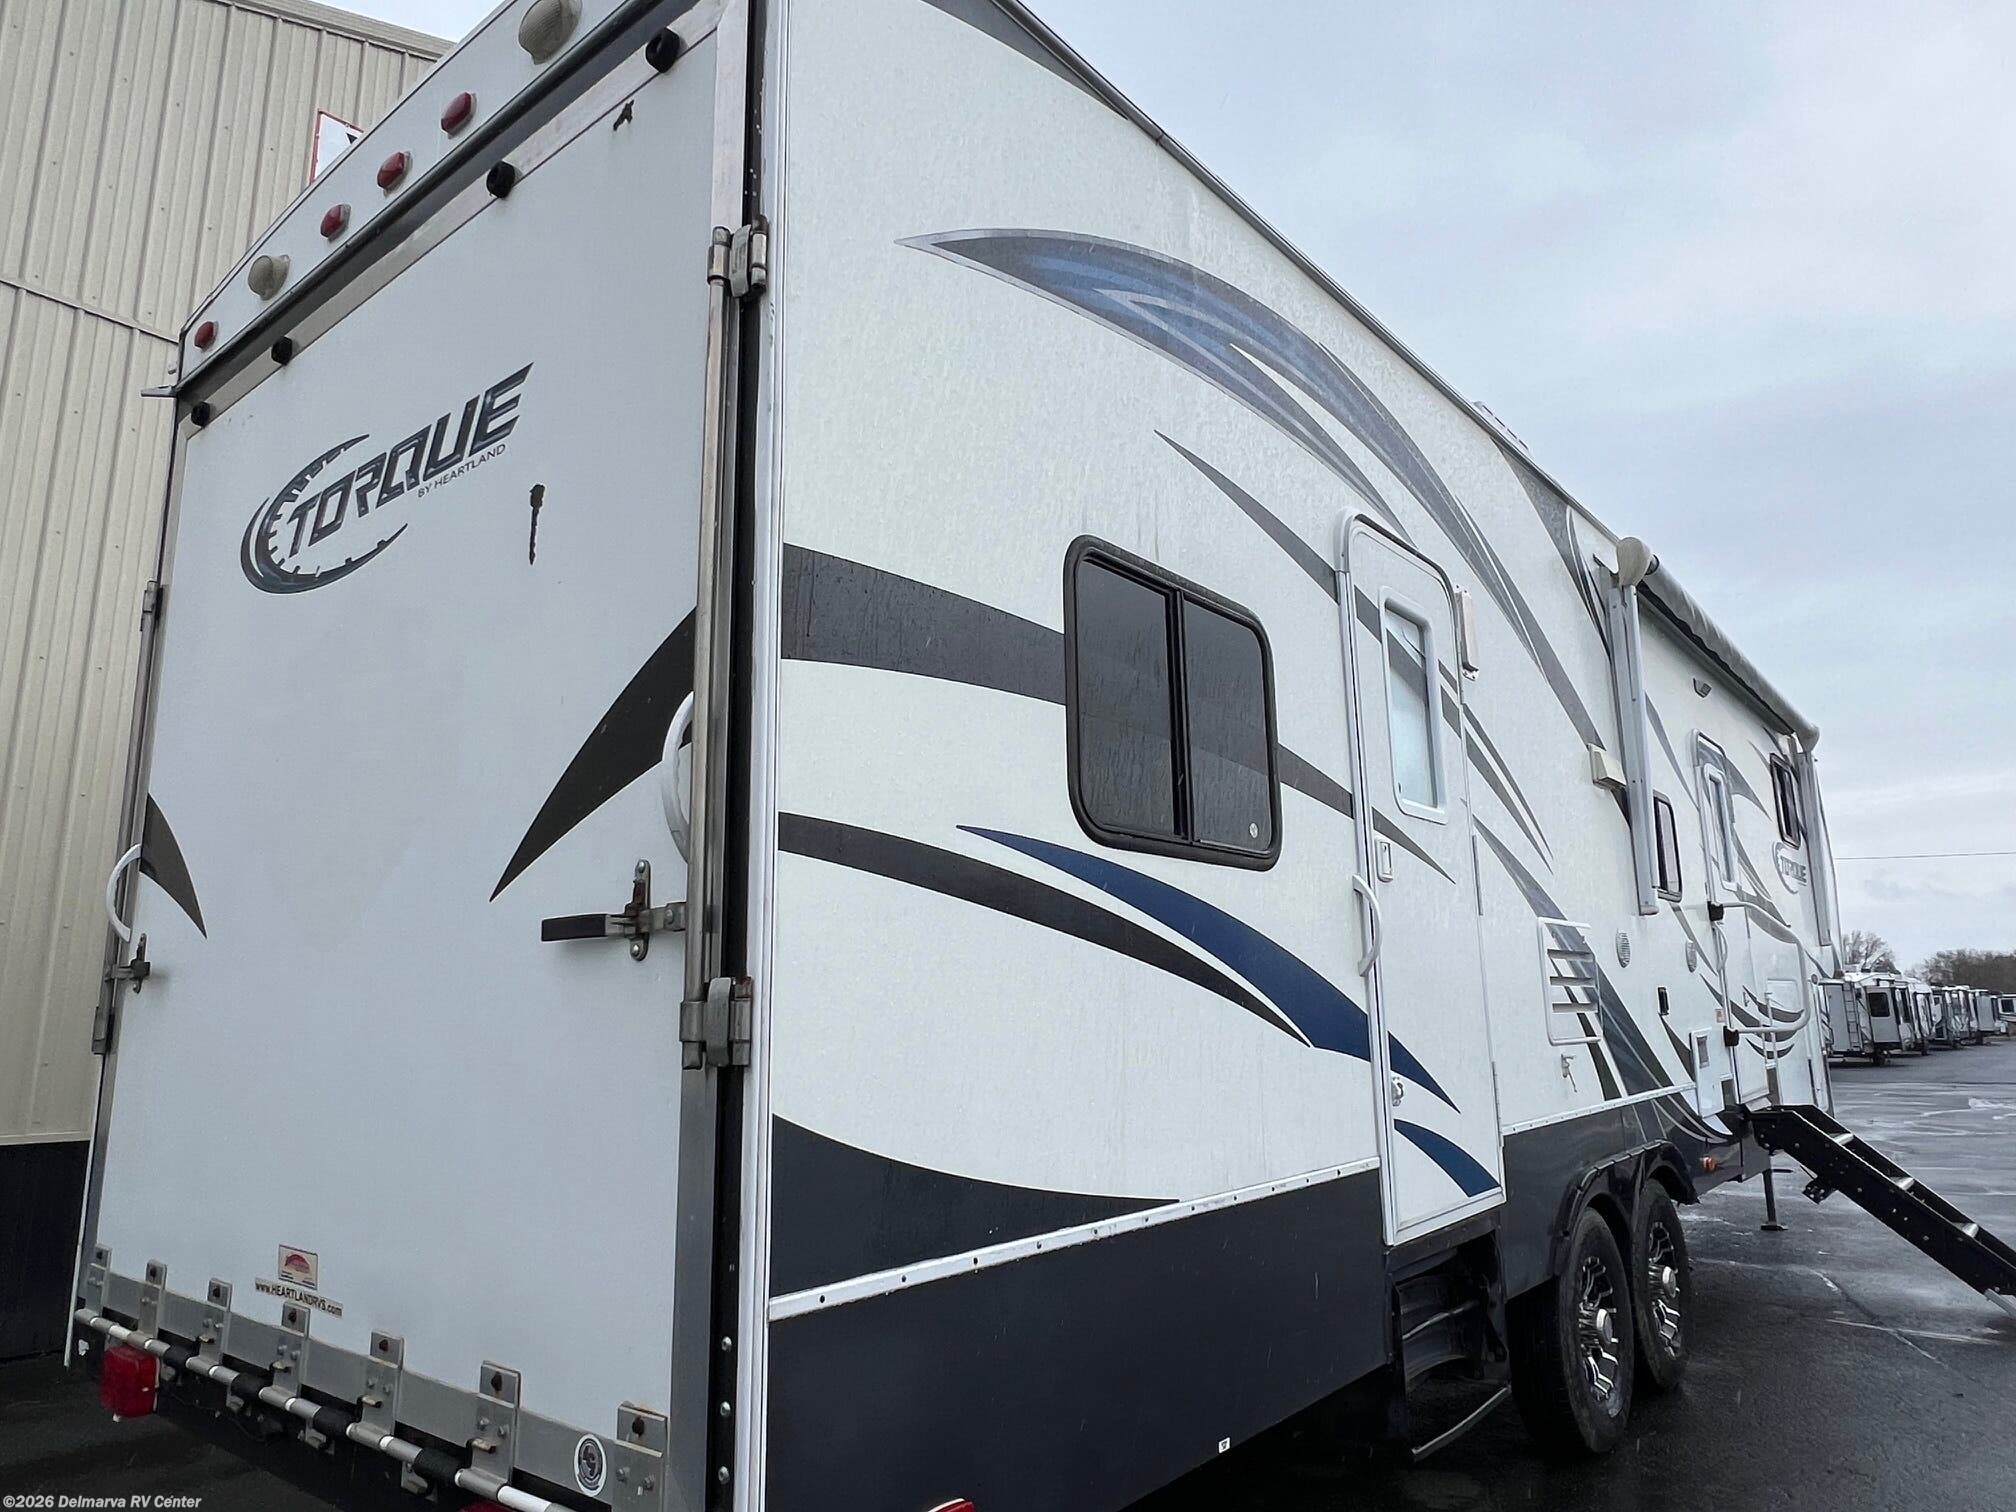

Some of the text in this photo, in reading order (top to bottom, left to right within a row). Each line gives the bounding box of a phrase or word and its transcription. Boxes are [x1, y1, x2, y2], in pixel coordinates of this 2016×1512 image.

[287, 362, 534, 558] TORQUE
[417, 443, 506, 498] BY HEARTLAND
